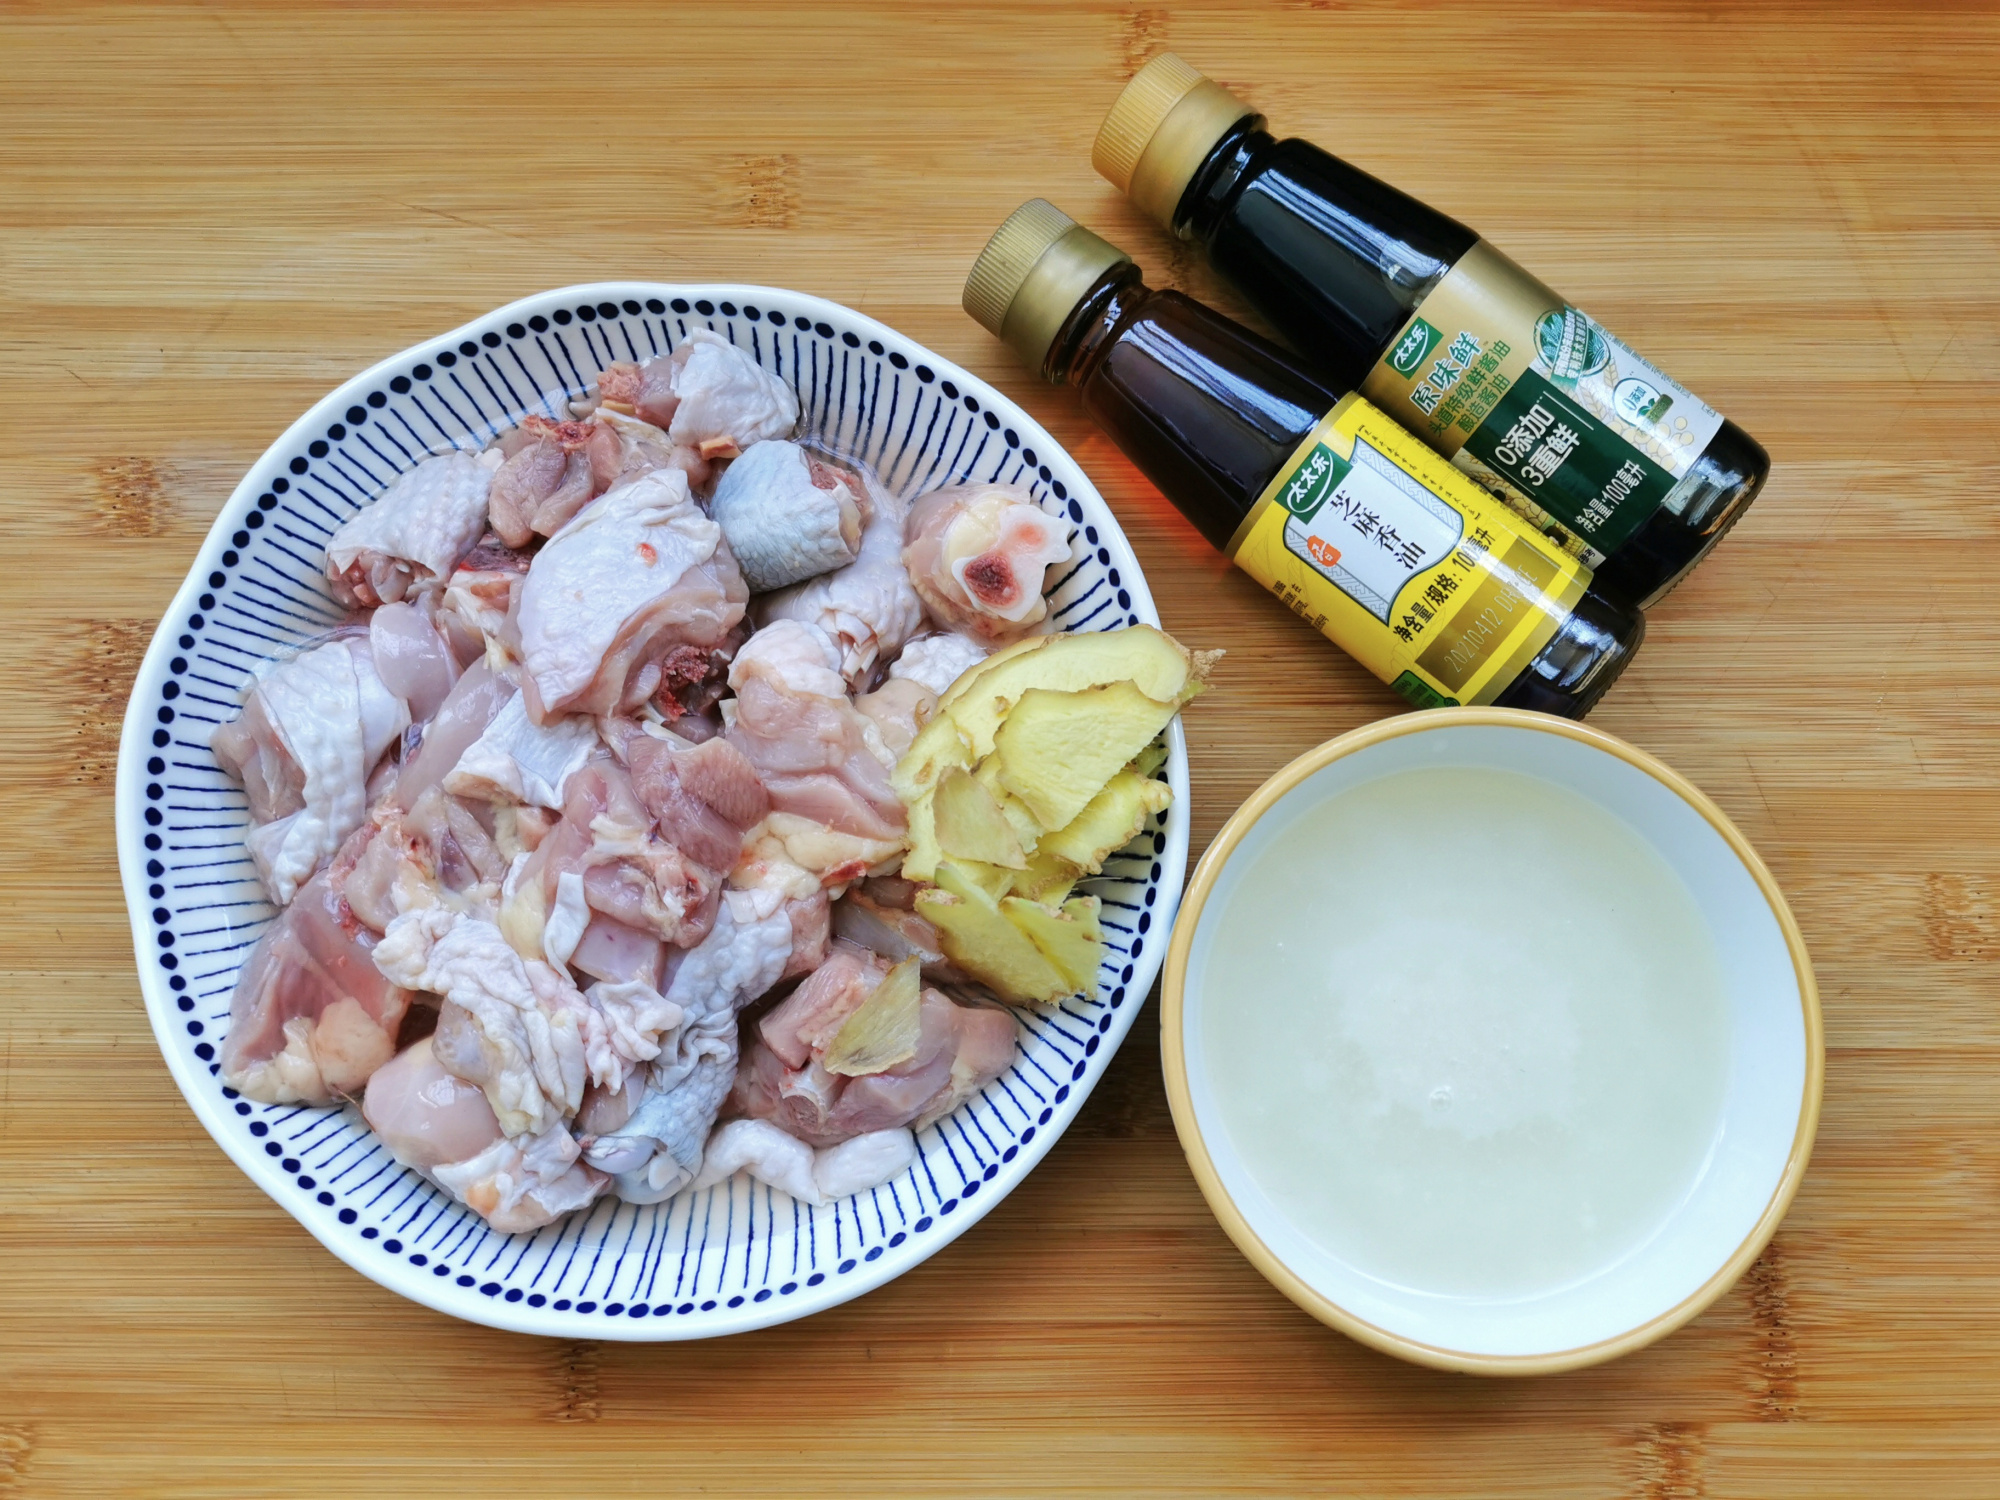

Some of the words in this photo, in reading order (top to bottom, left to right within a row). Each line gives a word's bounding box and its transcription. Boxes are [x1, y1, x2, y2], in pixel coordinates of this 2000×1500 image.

[1396, 324, 1427, 365] 太太乐
[1409, 330, 1482, 416] 原味鲜
[1428, 340, 1511, 437] 头道特级鲜酱油
[1455, 373, 1511, 433] 酿造酱油
[1290, 451, 1330, 504] 太太乐
[1520, 422, 1581, 487] 3重鲜
[1329, 489, 1427, 570] 芝麻香油
[1443, 606, 1504, 673] 20210412
